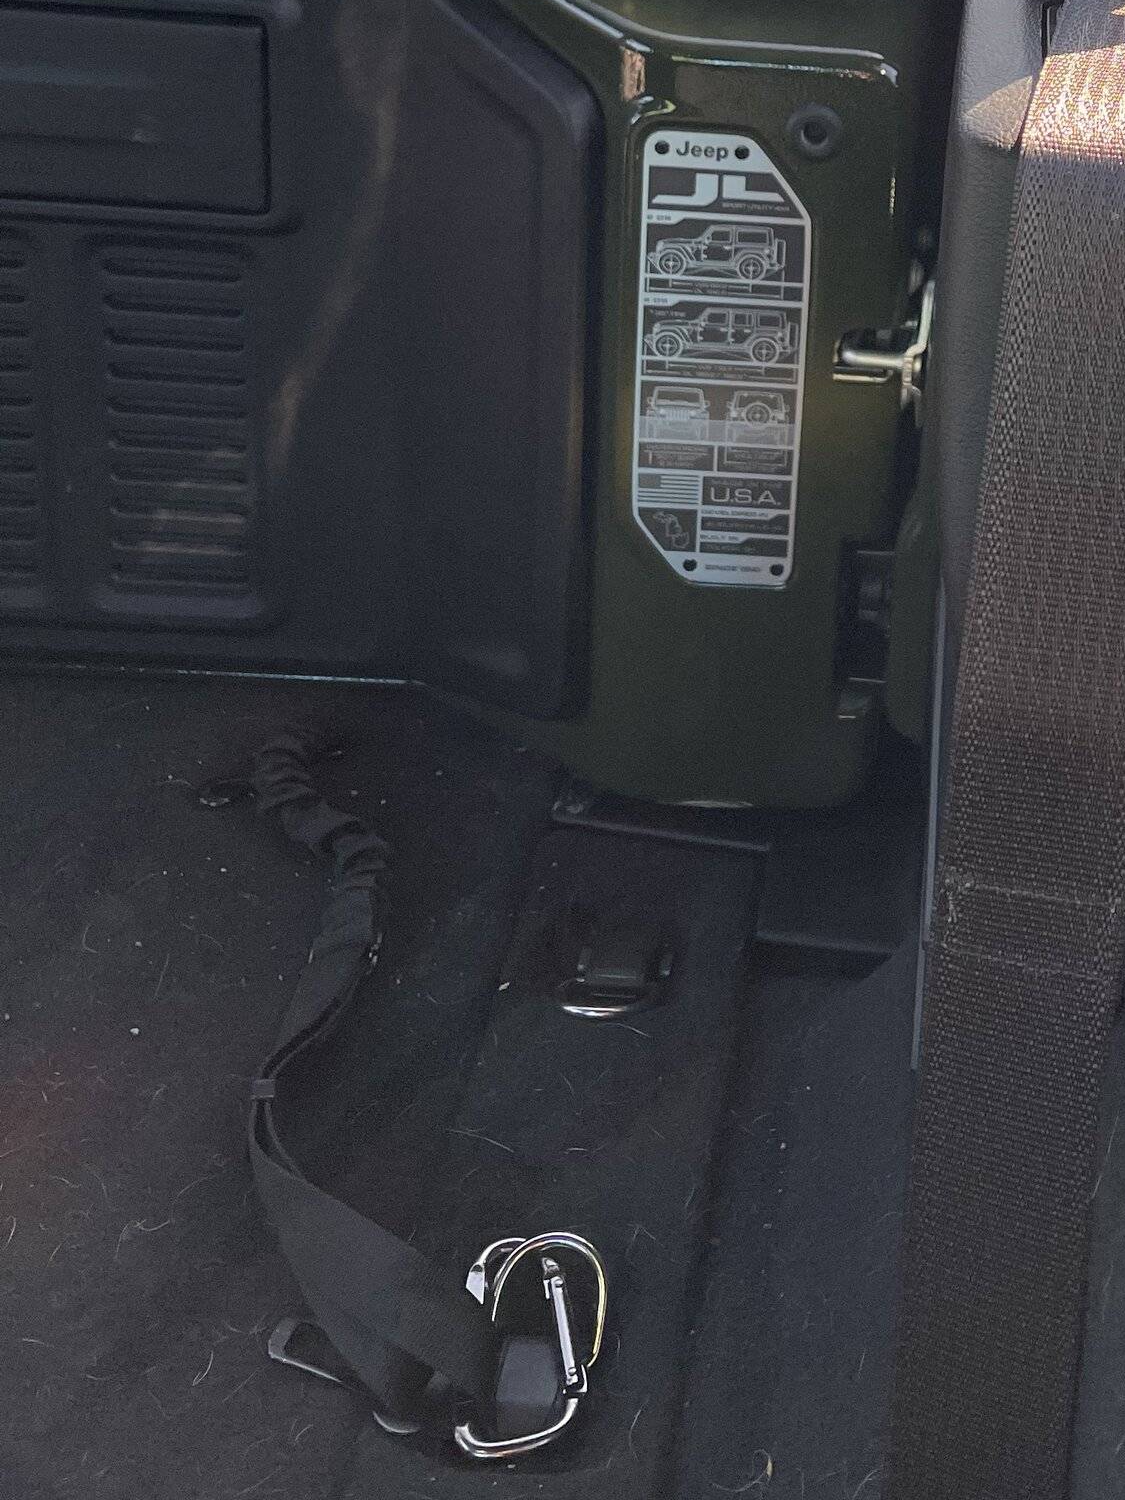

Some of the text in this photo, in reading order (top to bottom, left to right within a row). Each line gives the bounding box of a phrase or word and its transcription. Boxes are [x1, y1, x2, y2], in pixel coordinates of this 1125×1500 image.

[676, 141, 729, 161] Jeep
[651, 172, 785, 207] JL
[710, 486, 782, 506] U.S.A.
